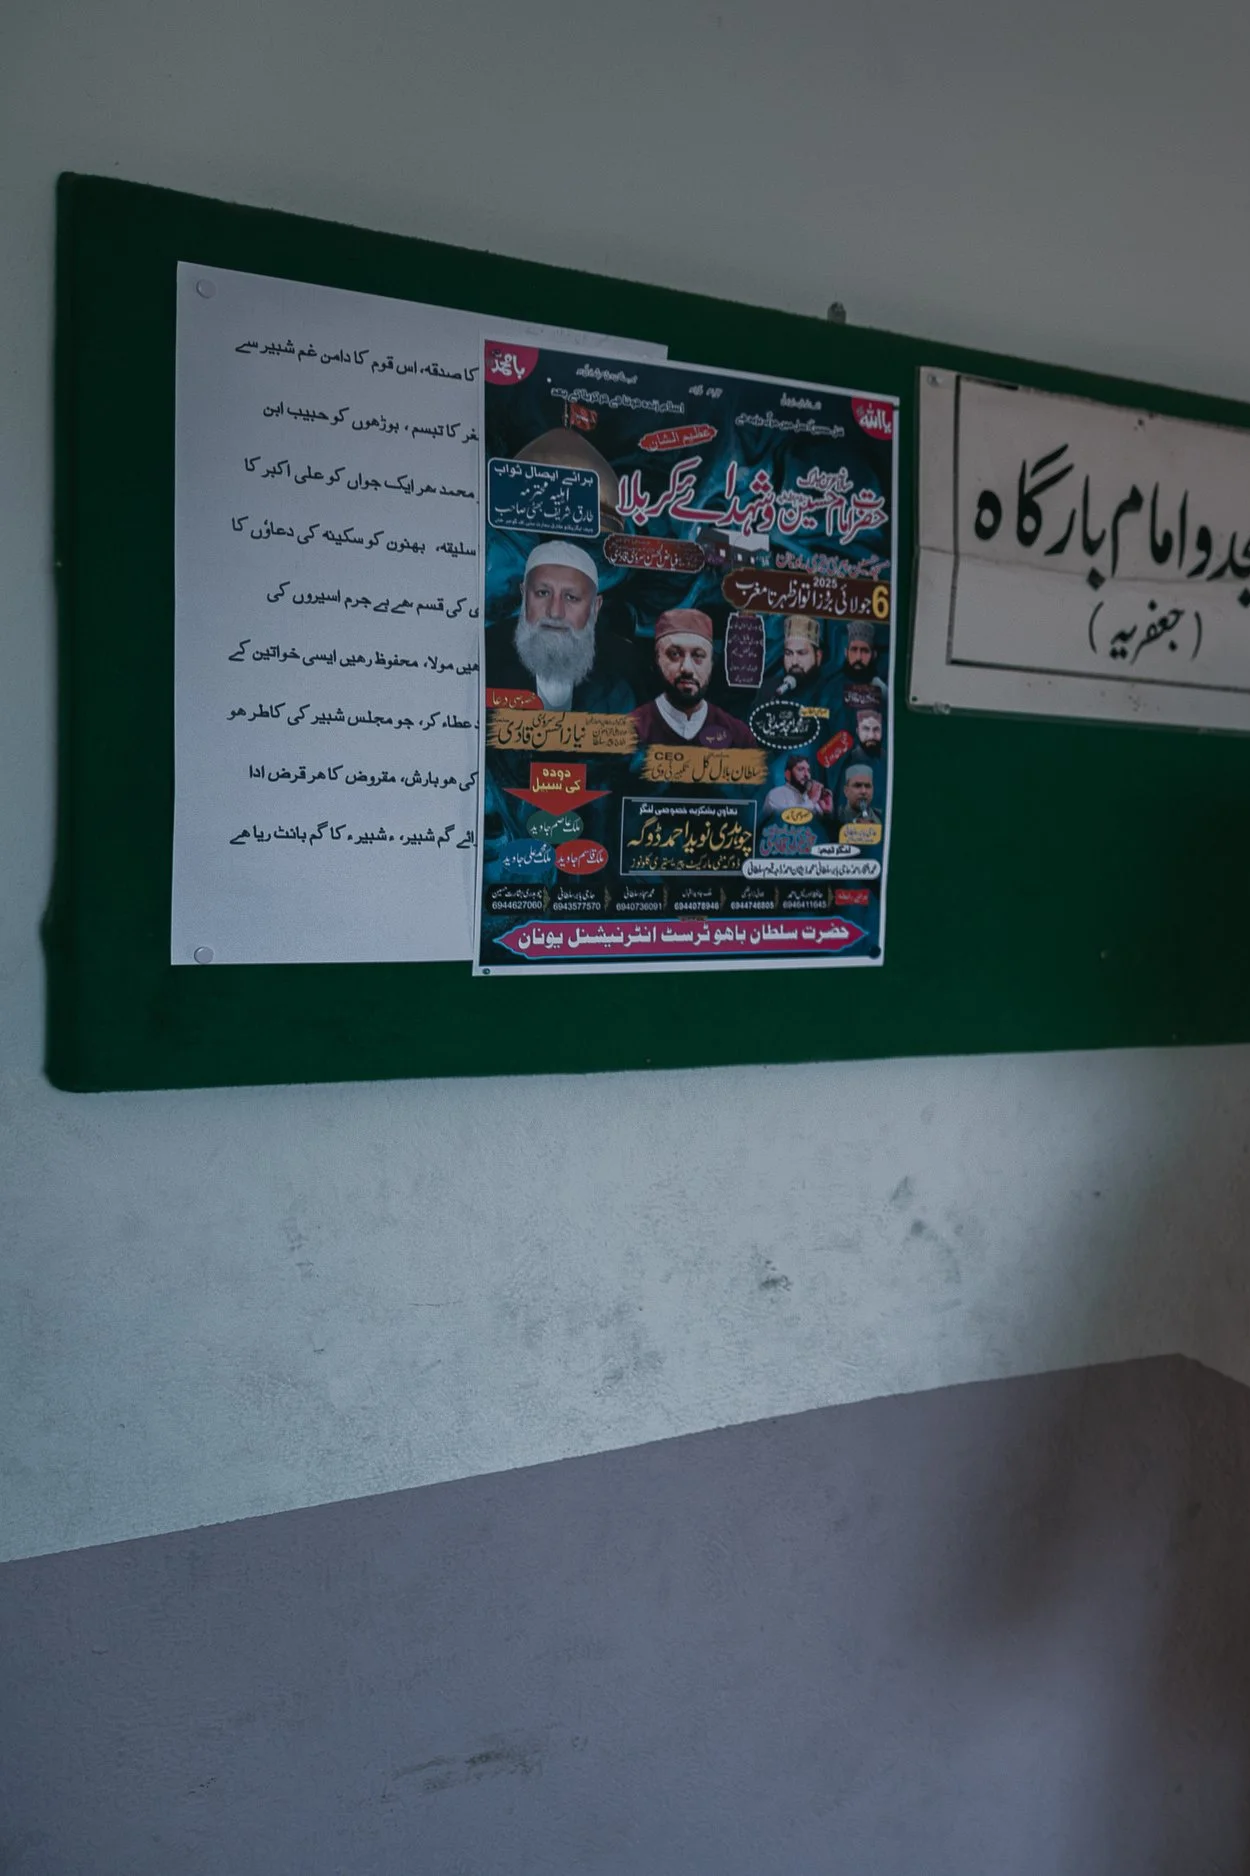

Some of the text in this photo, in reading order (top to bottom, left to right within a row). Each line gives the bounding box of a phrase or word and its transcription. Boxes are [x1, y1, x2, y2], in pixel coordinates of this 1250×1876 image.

[234, 341, 258, 354] سے
[263, 339, 296, 355] شبیر
[297, 343, 317, 362] غم
[320, 349, 351, 365] دامن
[353, 349, 370, 365] کا
[371, 356, 394, 373] قوم
[396, 360, 418, 375] اس
[263, 401, 284, 417] ابن
[287, 408, 329, 421] حبیب
[330, 406, 350, 426] کو
[446, 421, 461, 438] کا
[244, 455, 261, 473] کا
[261, 458, 291, 478] اکبر
[494, 463, 522, 478] ثواب
[293, 464, 325, 486] علی
[325, 466, 346, 486] کو
[383, 474, 415, 494] ایک
[440, 485, 475, 499] محمد
[231, 516, 249, 532] کا
[973, 443, 1107, 590] بارگاہ
[296, 522, 321, 545] کی
[1112, 481, 1190, 579] امام
[364, 530, 385, 550] کو
[266, 581, 291, 603] کی
[291, 589, 342, 606] اسیروں
[872, 583, 890, 620] 6
[343, 595, 373, 610] جرم
[415, 599, 445, 615] قسم
[445, 597, 468, 619] کی
[227, 638, 252, 662] کے
[251, 644, 302, 663] خواتین
[301, 648, 338, 667] ایسی
[374, 650, 420, 670] محفوظ
[286, 703, 311, 726] کی
[309, 708, 346, 727] شبیر
[348, 710, 394, 728] مجلس
[393, 718, 415, 731] جو
[654, 751, 685, 761] CEO
[248, 763, 266, 780] ادا
[267, 765, 307, 785] قرض
[327, 764, 344, 782] کا
[344, 770, 397, 786] مقروض
[532, 777, 582, 794] کی سبیل
[273, 824, 308, 841] بانٹ
[308, 820, 329, 847] گم
[329, 823, 347, 842] کا
[491, 900, 543, 911] 6944627060
[552, 901, 601, 911] 6943577570
[518, 926, 564, 950] یونان
[567, 926, 657, 949] انٹرنیشنل
[660, 924, 712, 947] ٹرسٹ
[749, 924, 799, 945] سلطان
[801, 921, 851, 944] حضرت
